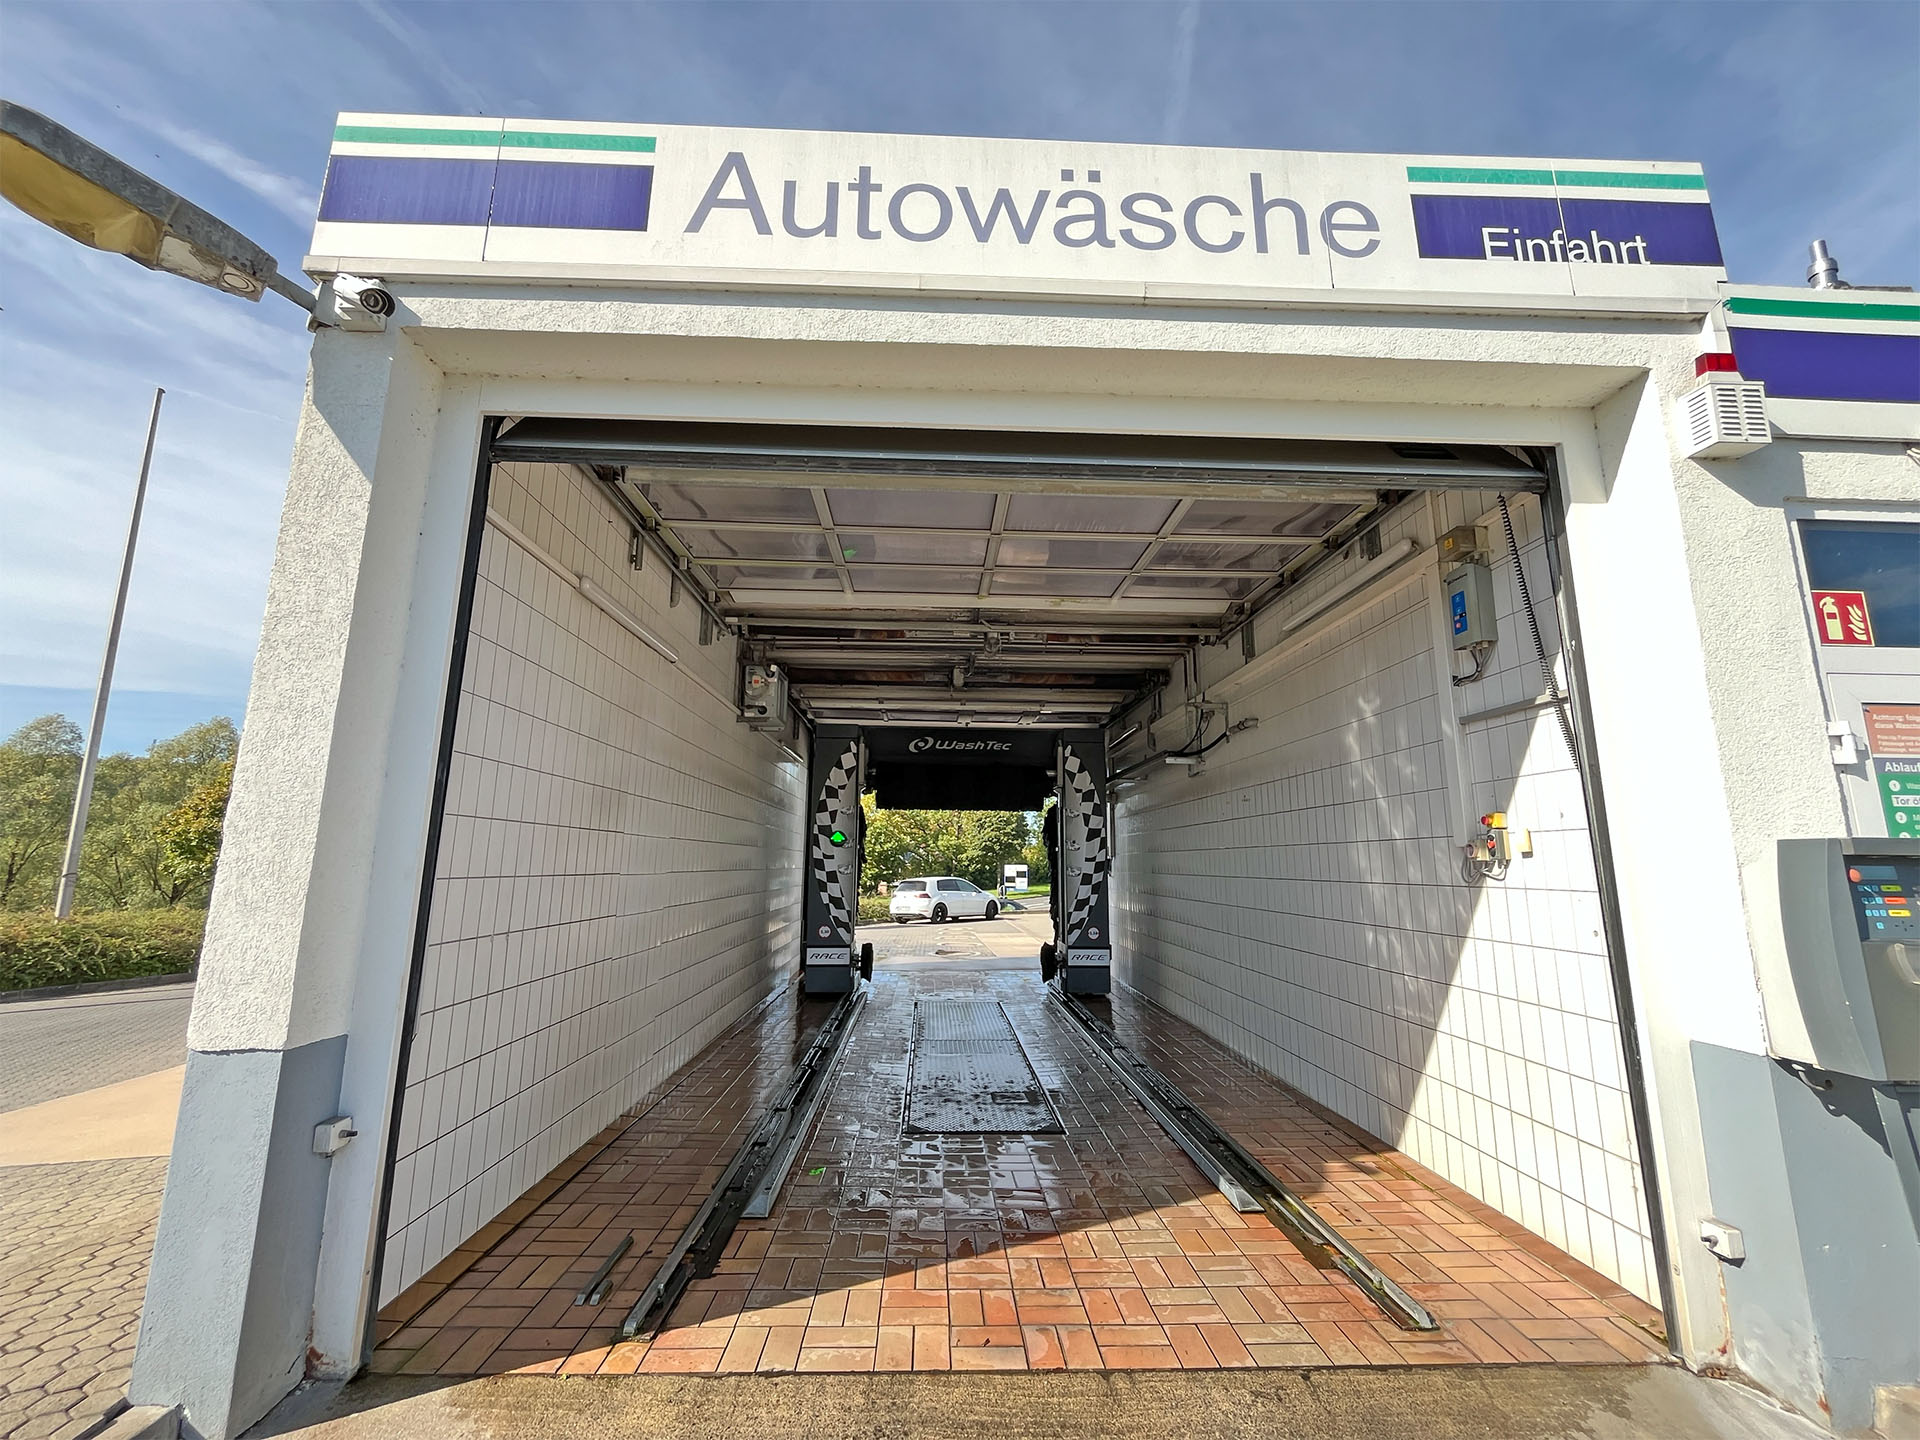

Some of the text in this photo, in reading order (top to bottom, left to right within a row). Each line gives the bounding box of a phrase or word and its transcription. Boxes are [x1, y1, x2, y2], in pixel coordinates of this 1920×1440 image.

[683, 151, 1381, 258] Autowäsche
[1481, 227, 1651, 264] Einfahrt
[935, 740, 1012, 750] WashTec
[1893, 796, 1910, 805] Tor
[810, 952, 848, 960] RACE
